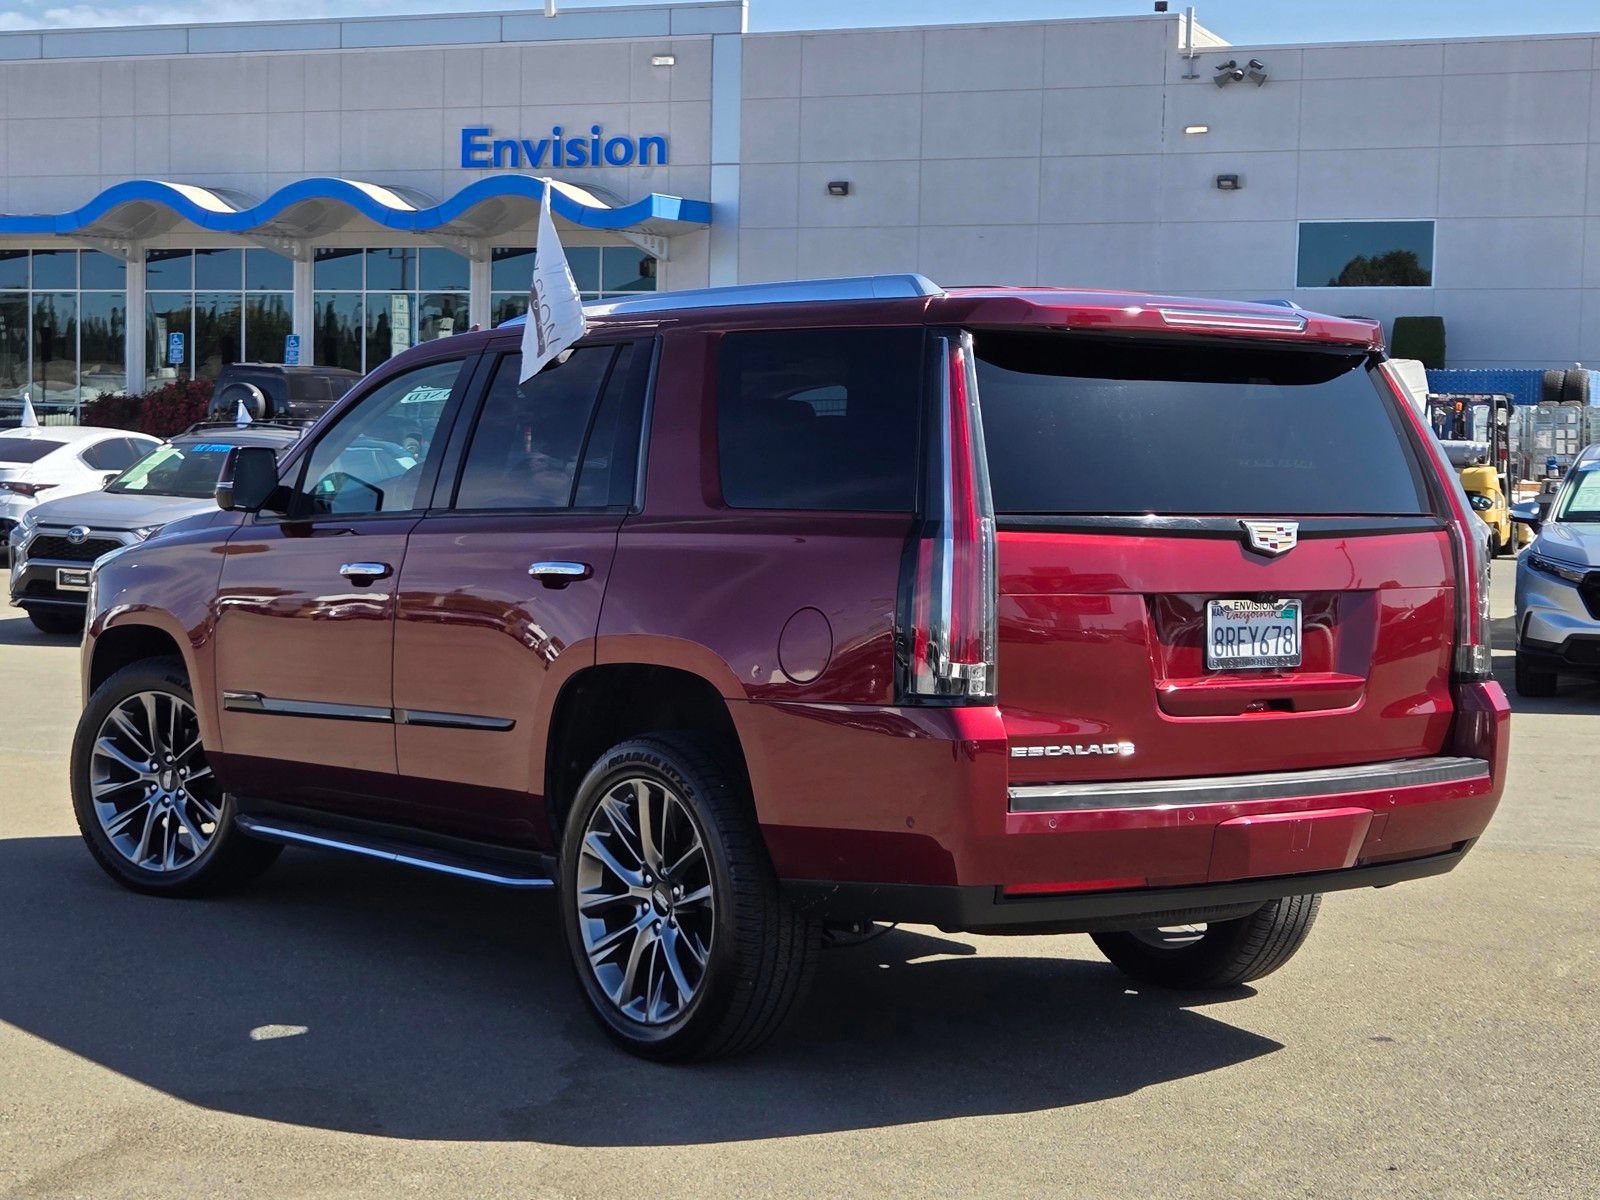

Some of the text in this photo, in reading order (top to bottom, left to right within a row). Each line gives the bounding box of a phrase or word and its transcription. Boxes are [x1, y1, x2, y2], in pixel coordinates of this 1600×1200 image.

[461, 125, 667, 168] Envision
[1234, 601, 1275, 611] ENVISION
[1215, 626, 1293, 656] 8RFY678
[1011, 742, 1135, 757] ESCALADE
